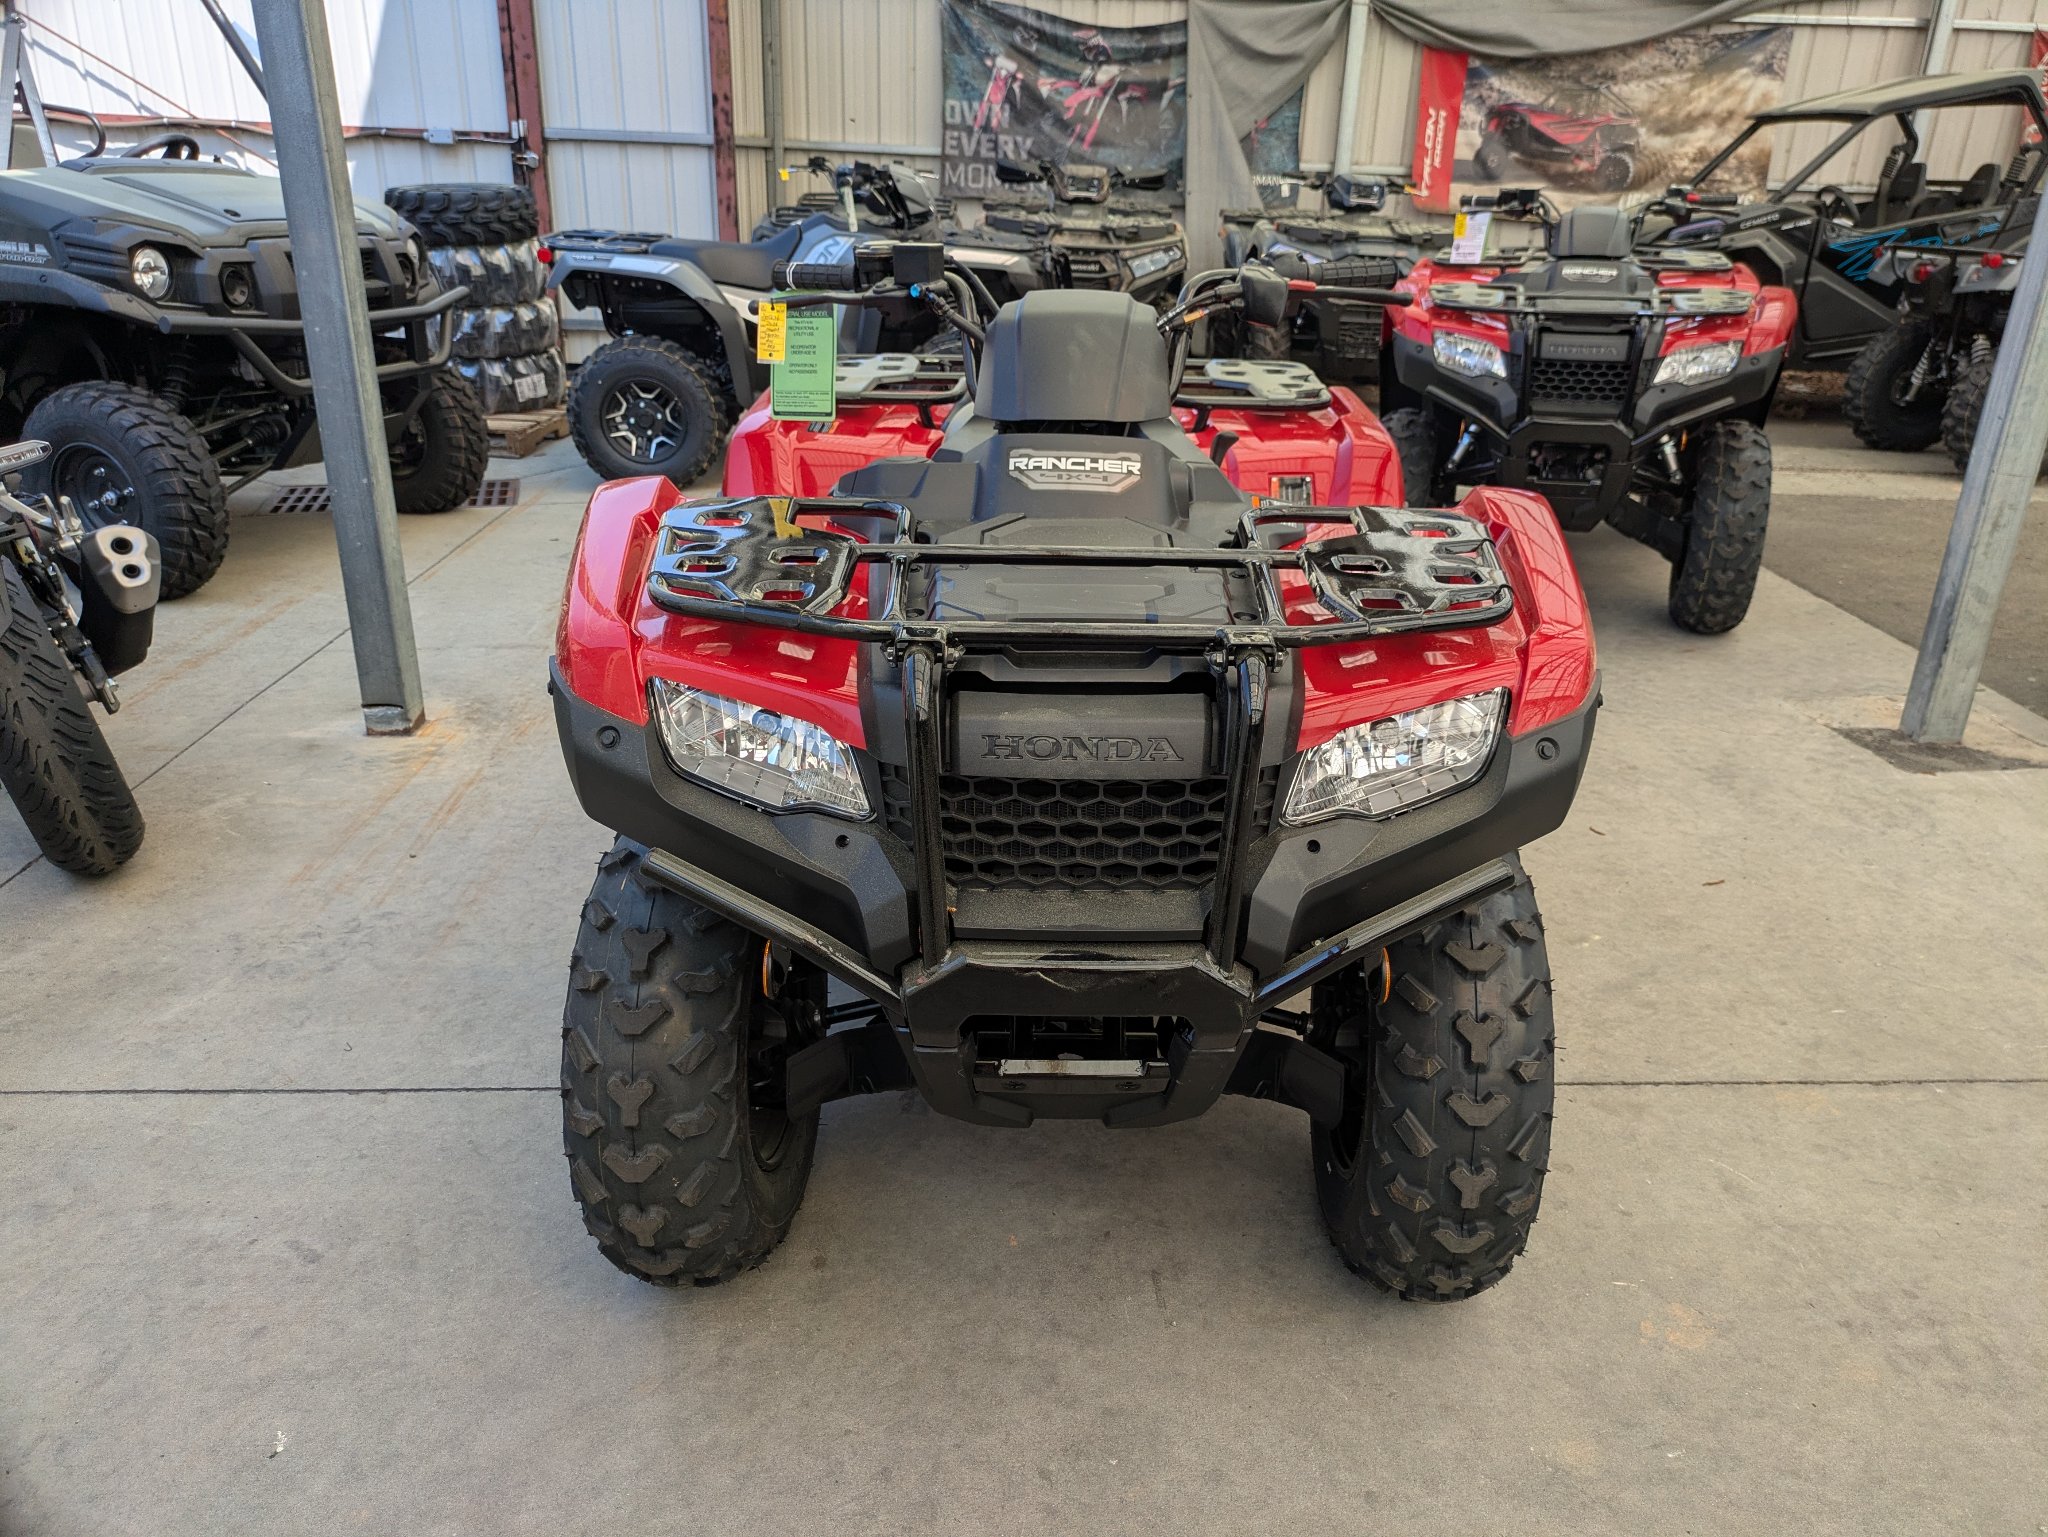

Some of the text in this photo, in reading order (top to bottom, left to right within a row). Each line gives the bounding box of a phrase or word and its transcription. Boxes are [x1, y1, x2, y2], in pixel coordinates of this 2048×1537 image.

[945, 99, 1010, 128] OWN
[944, 128, 1034, 160] EVERY
[1008, 457, 1141, 475] RANCHER
[980, 734, 1184, 762] HONDA
